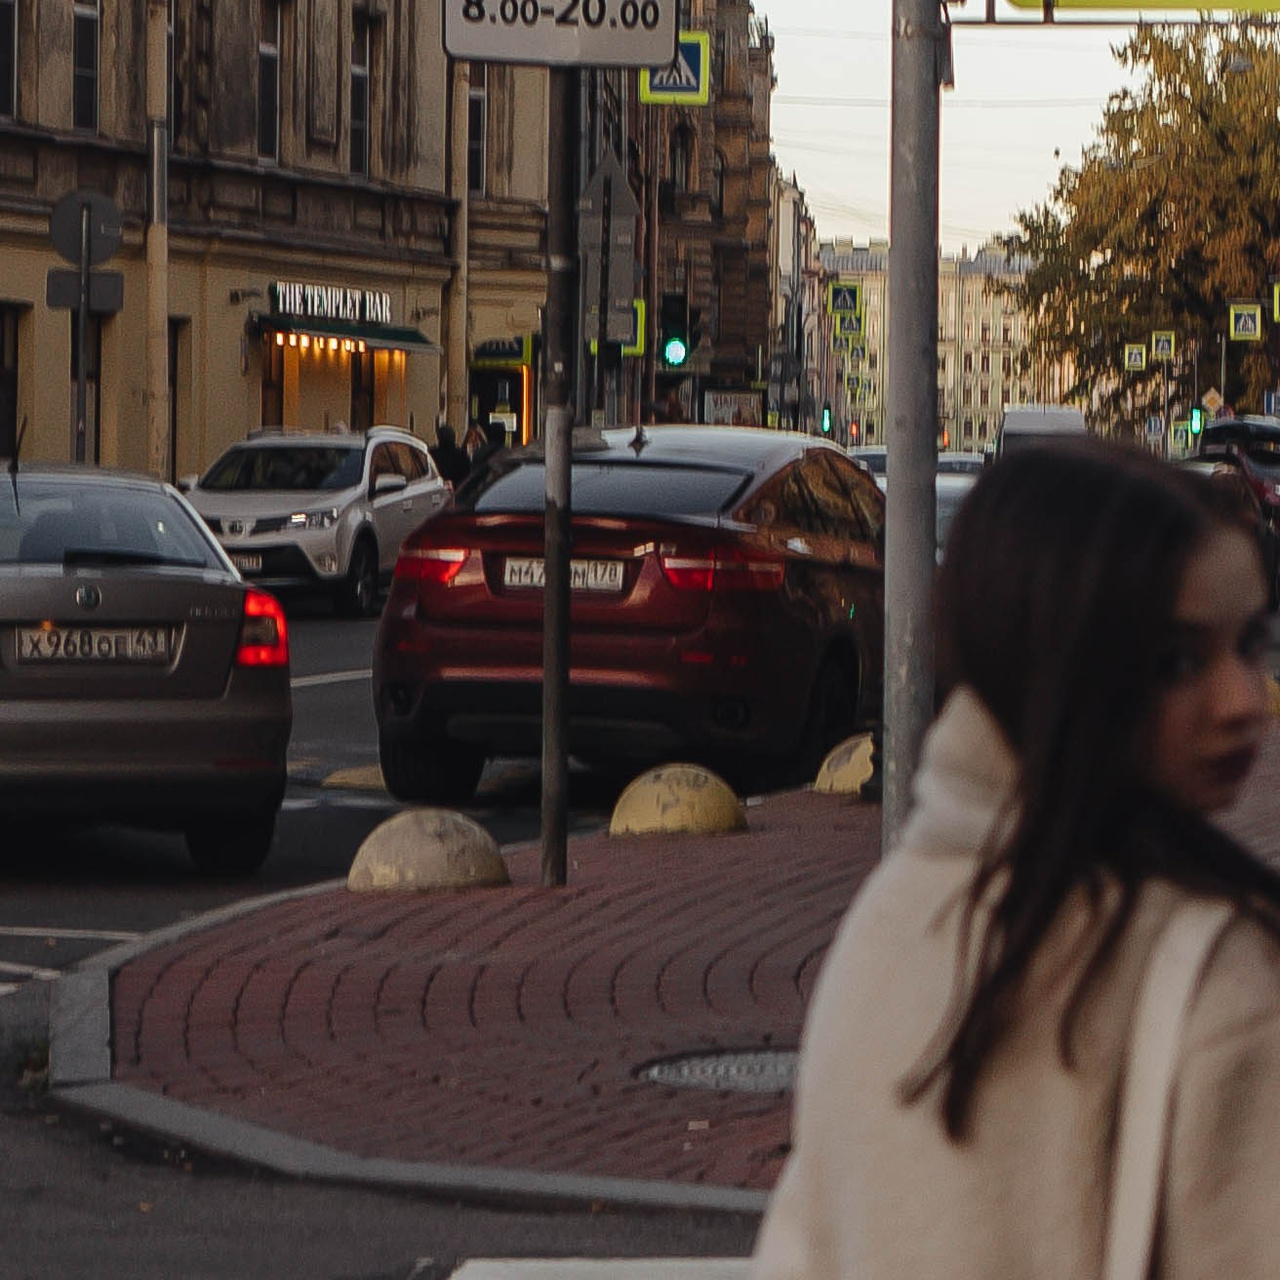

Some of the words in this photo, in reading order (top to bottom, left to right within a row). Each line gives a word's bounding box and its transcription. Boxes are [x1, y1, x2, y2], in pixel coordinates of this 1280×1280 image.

[276, 280, 303, 316] THE
[304, 283, 362, 321] TEMPLET
[365, 290, 391, 324] BAR
